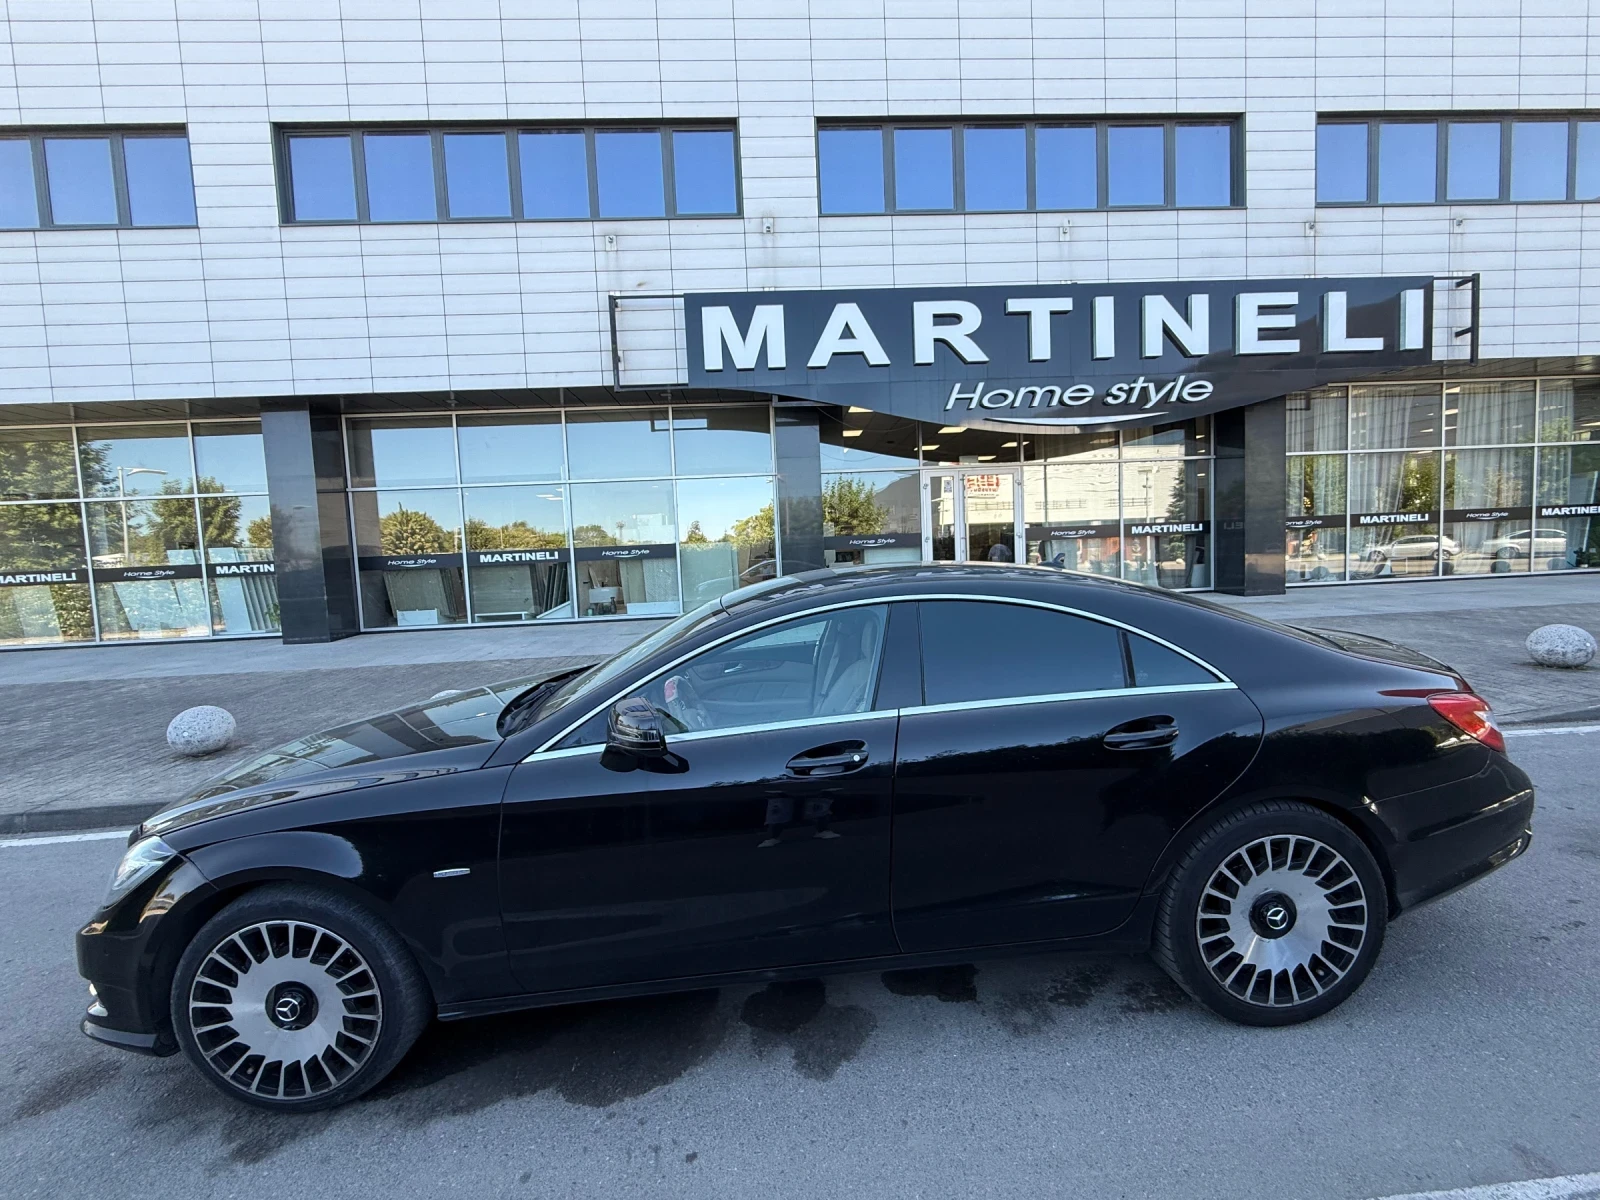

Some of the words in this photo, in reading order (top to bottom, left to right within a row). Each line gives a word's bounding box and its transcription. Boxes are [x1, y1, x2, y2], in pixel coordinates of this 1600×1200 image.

[702, 288, 1424, 371] MARTINELI
[944, 381, 1095, 412] Home
[1103, 375, 1214, 409] style
[1360, 513, 1429, 524] MARTINELI
[1131, 523, 1203, 534] MARTINELI
[479, 551, 559, 563] MARTINELI
